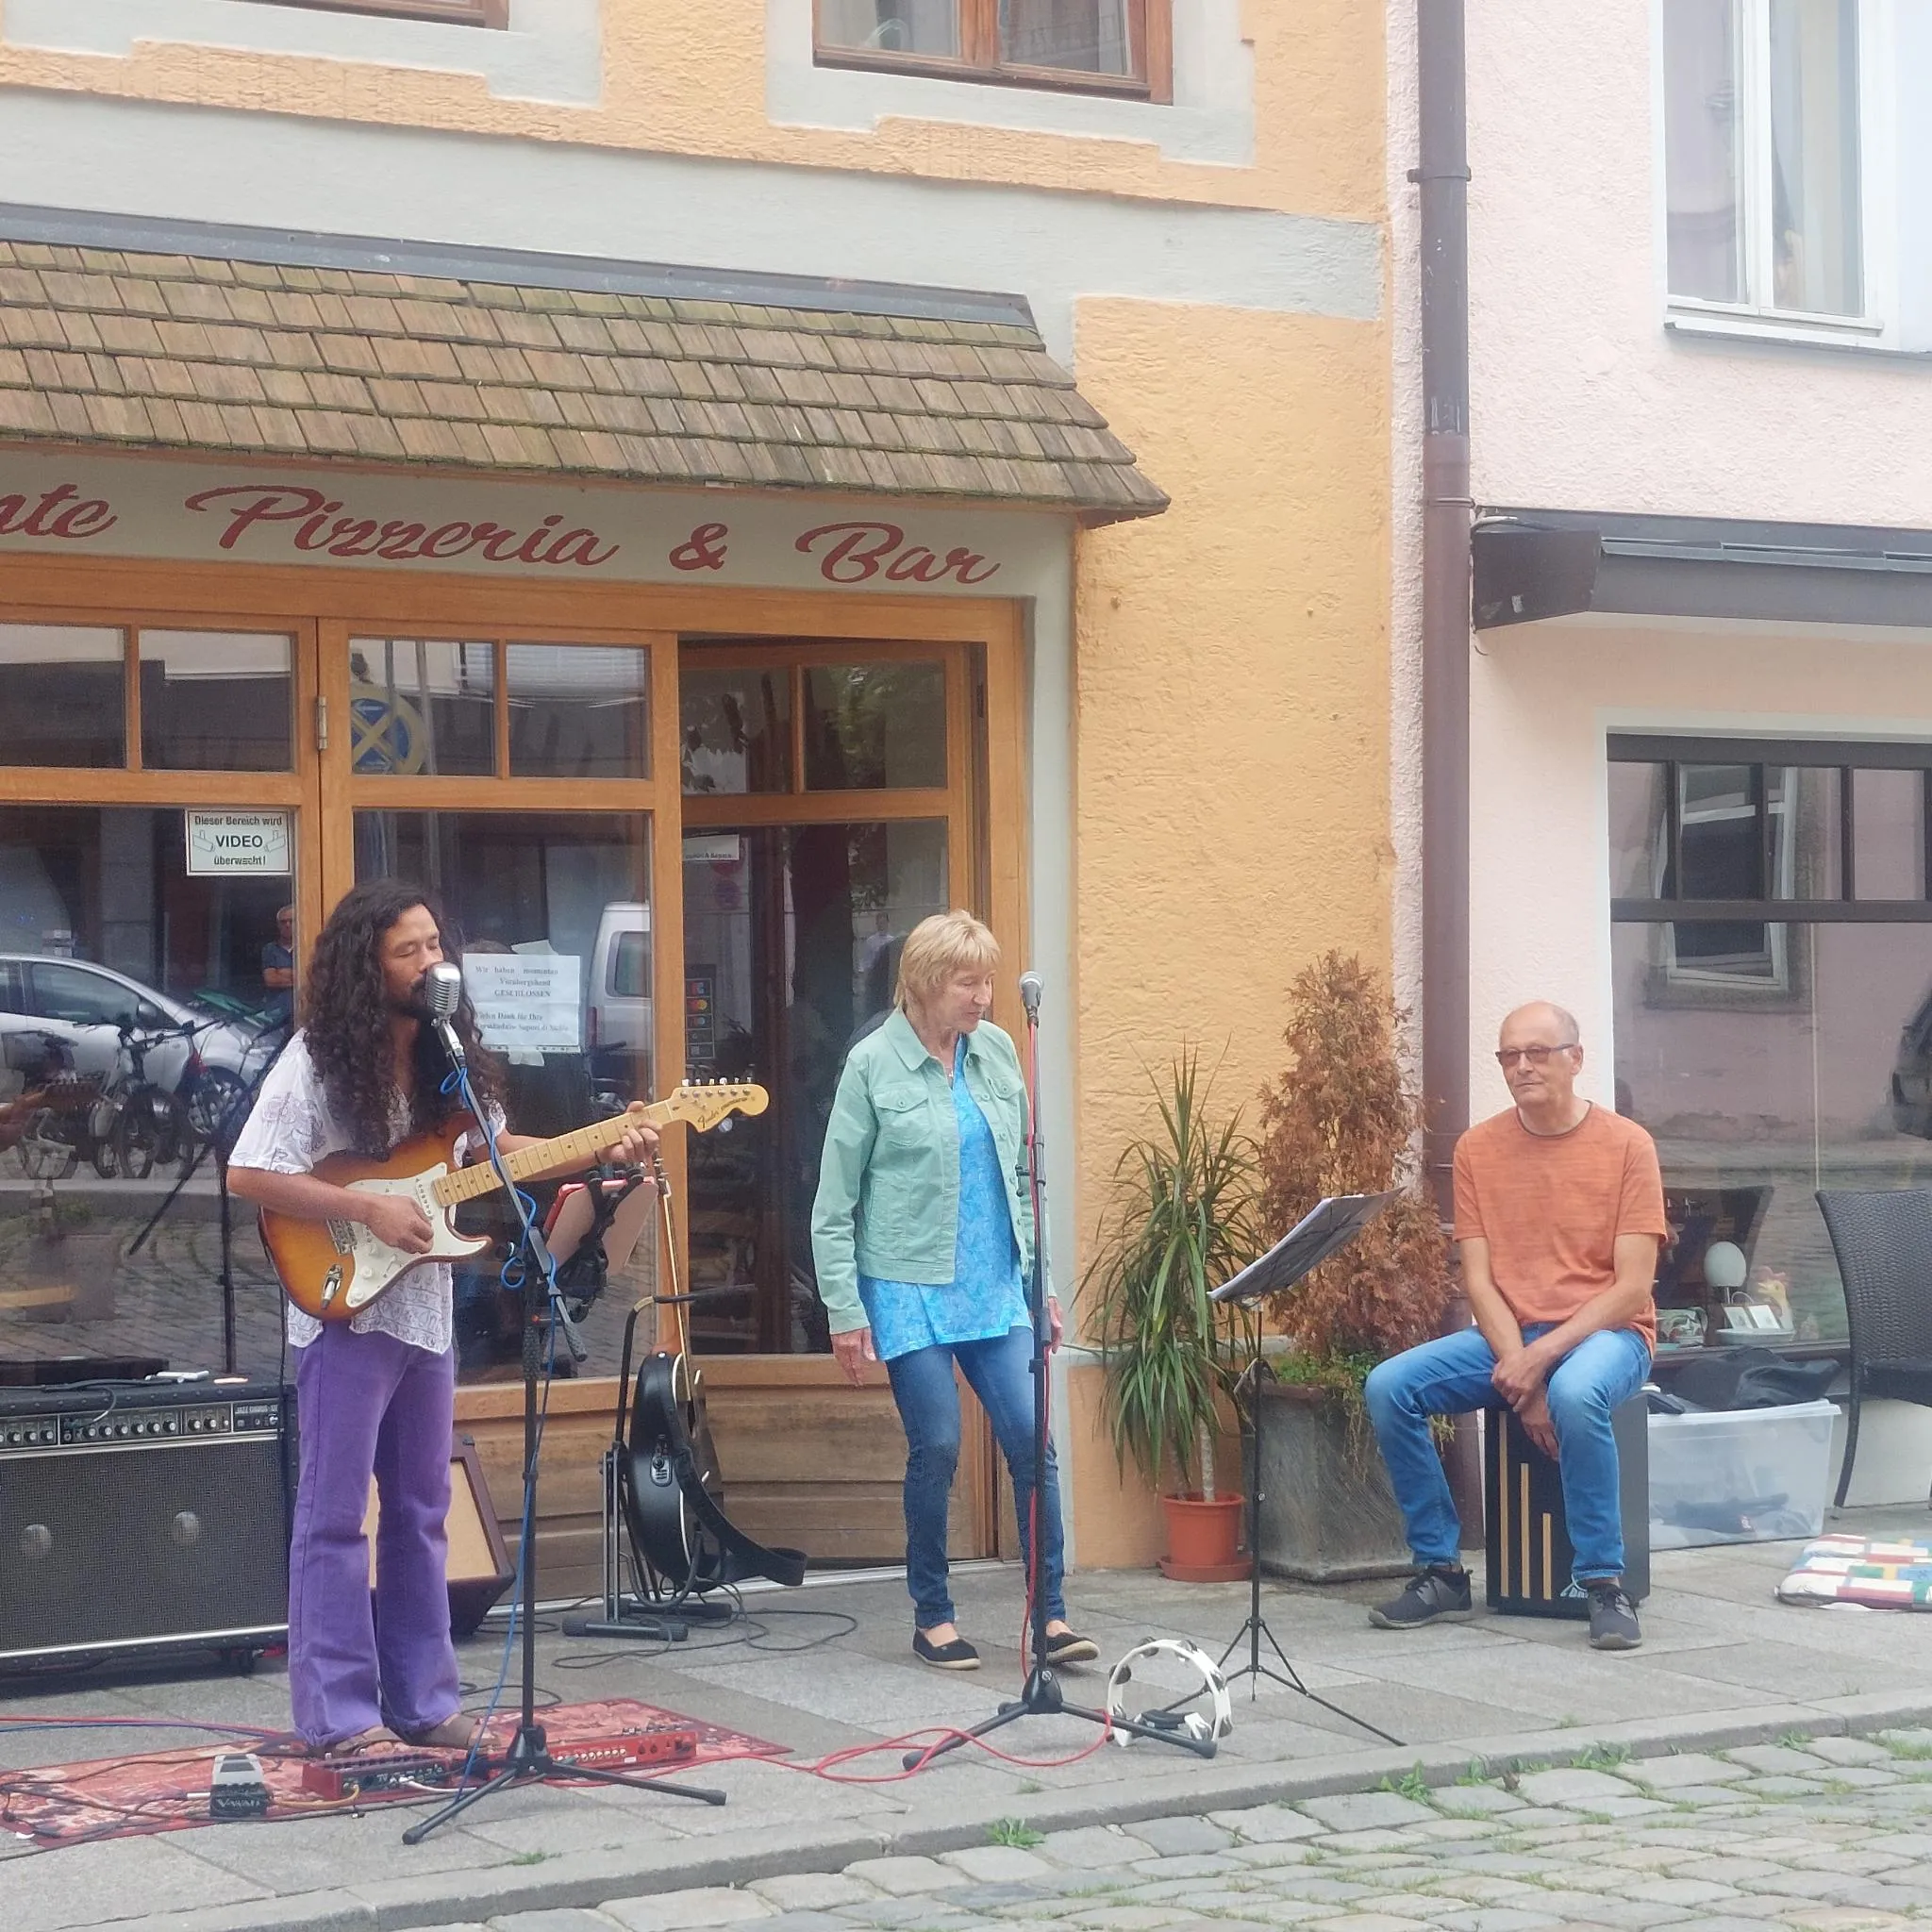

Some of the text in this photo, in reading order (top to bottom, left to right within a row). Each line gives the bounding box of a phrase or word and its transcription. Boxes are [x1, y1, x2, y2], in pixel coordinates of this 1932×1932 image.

[184, 485, 620, 565] Pizzeria
[669, 523, 728, 570] &
[794, 522, 1001, 584] Bar
[194, 815, 283, 825] Dieser Bereich wird
[215, 835, 263, 848] VIDEO
[494, 989, 551, 997] GESCHLOSSEN
